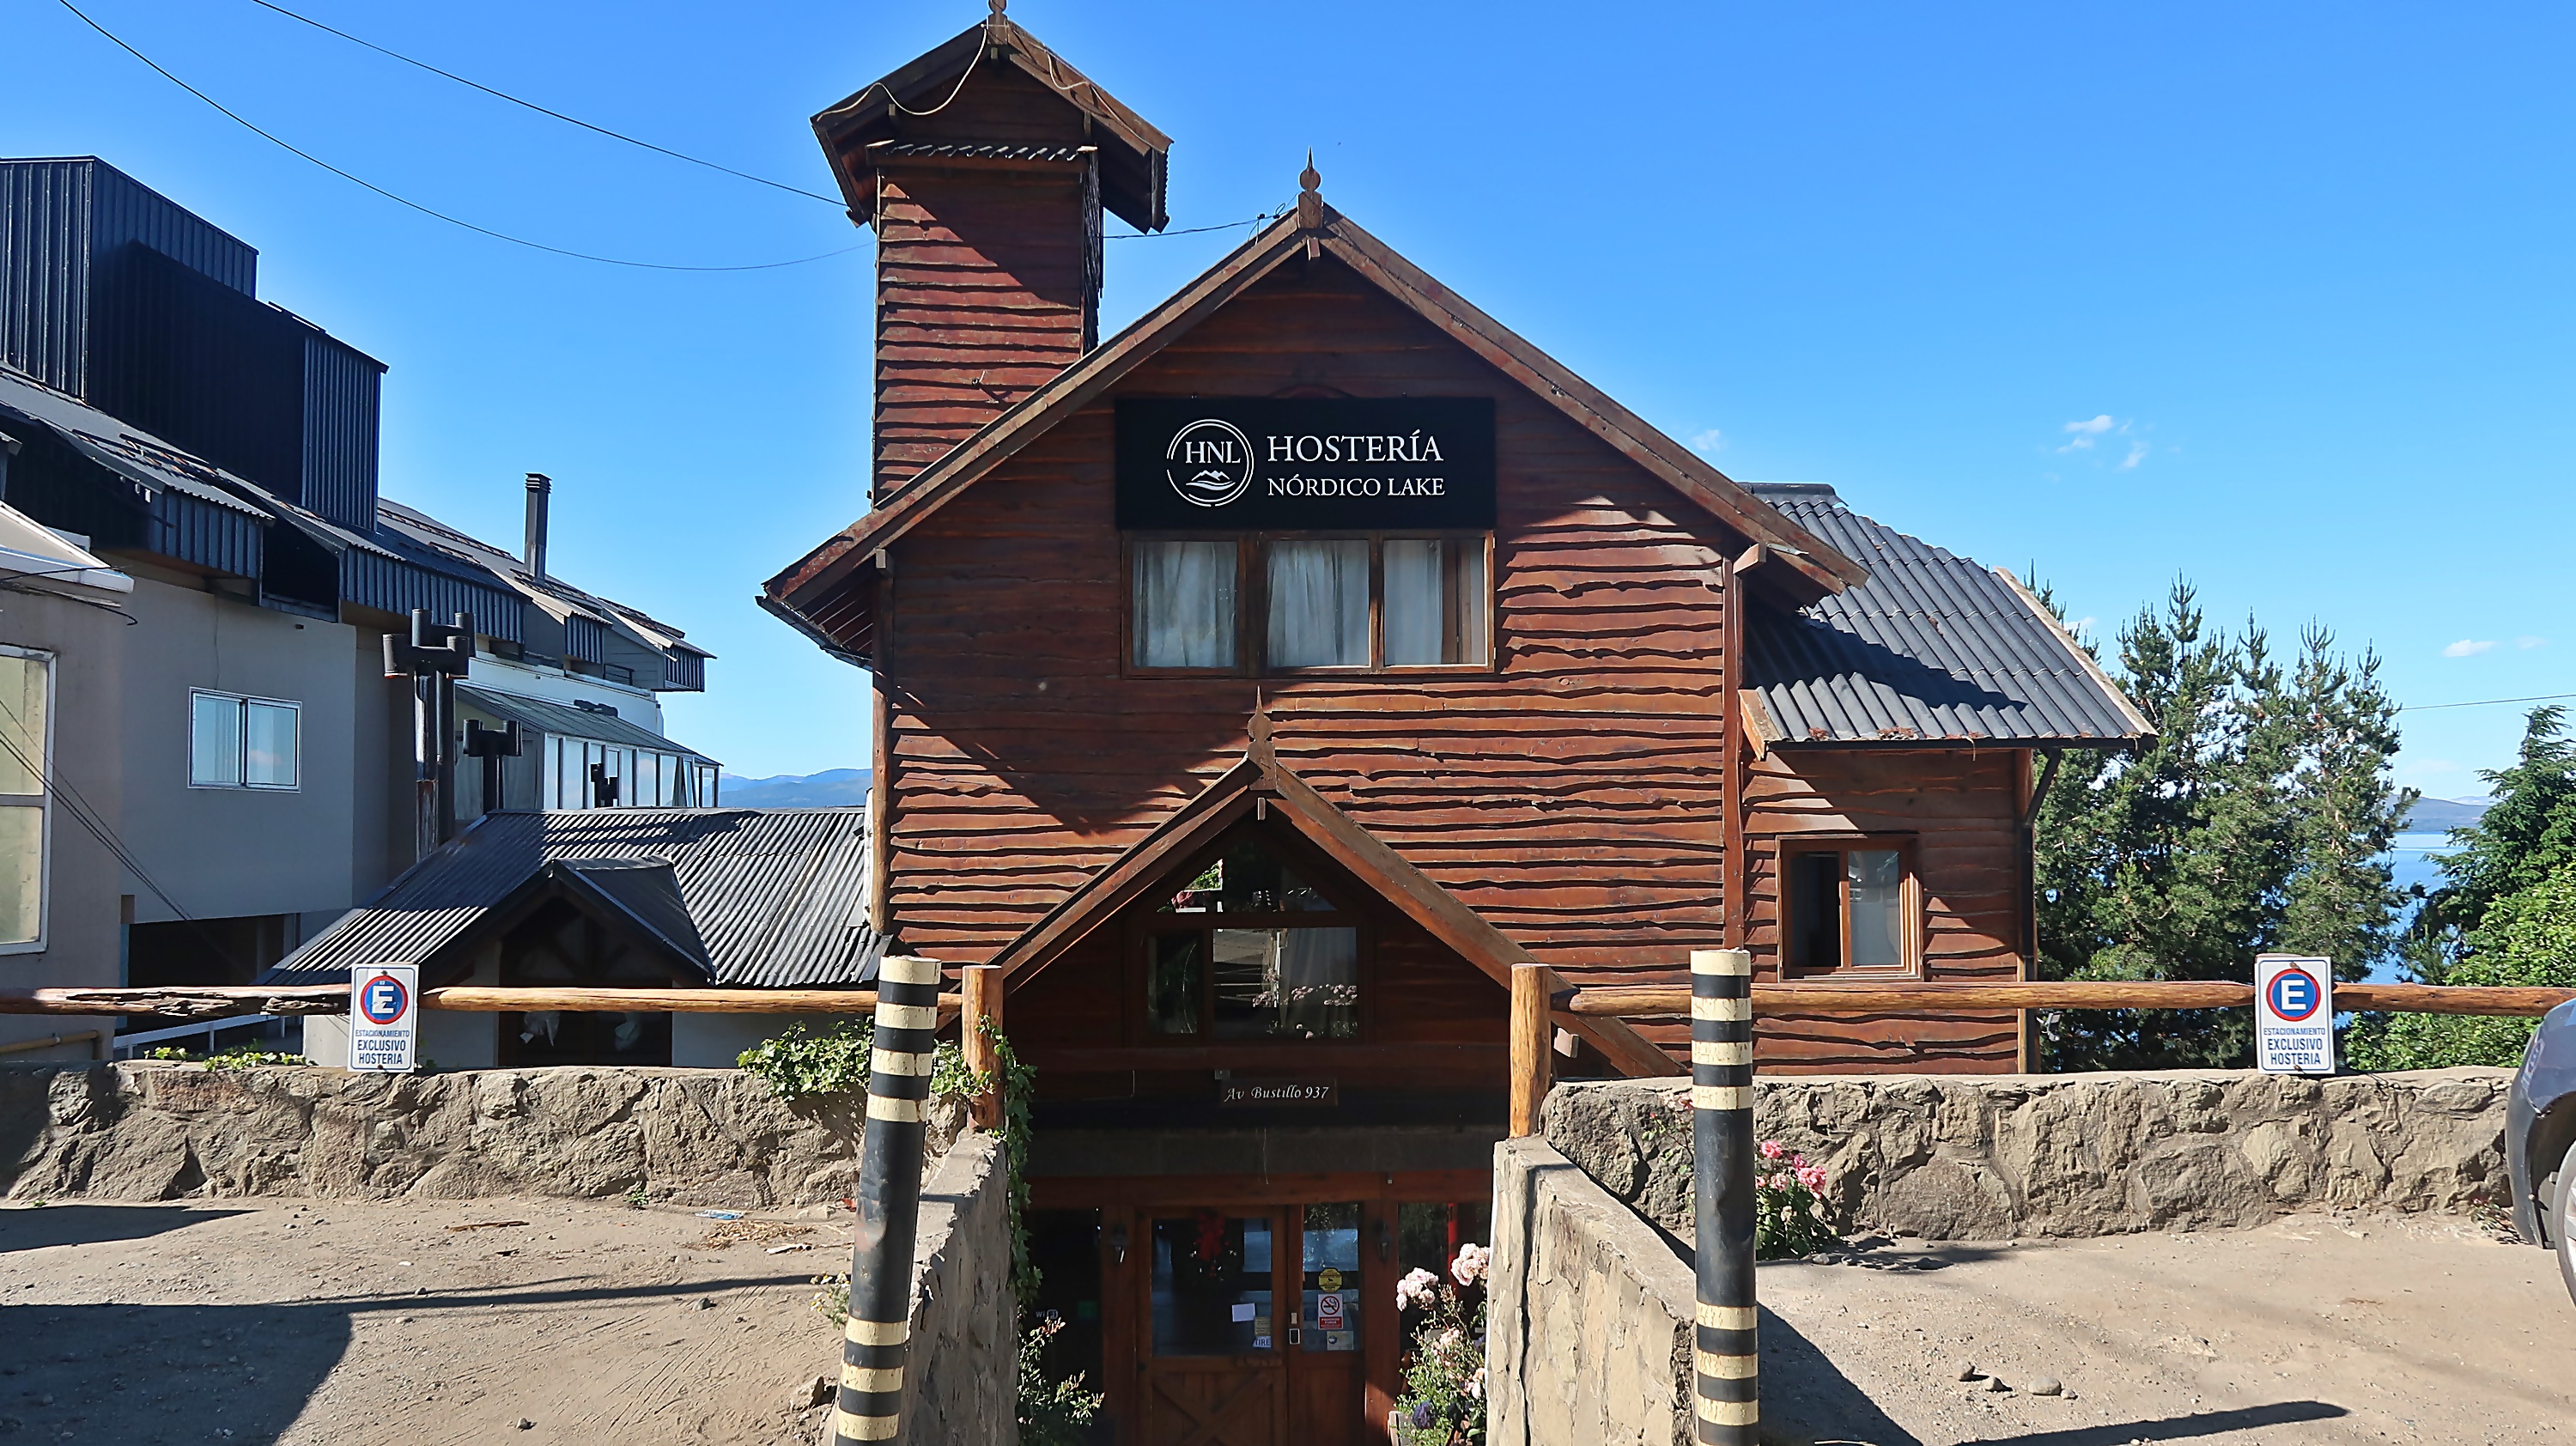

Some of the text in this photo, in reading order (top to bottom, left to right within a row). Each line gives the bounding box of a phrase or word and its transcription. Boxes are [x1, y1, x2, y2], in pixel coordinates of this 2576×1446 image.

[1185, 440, 1241, 464] HNL
[1267, 428, 1444, 463] HOSTERÍA
[1267, 473, 1445, 496] NÓRDICO LAKE
[372, 985, 394, 1014] E
[2281, 979, 2306, 1010] E
[2263, 1027, 2325, 1036] ESTACIONAMIENTO
[357, 1039, 406, 1051] EXCLUSIVO
[2267, 1038, 2323, 1050] EXCLUSIVO
[359, 1053, 403, 1064] HOSTERIA
[2270, 1052, 2322, 1065] HOSTERIA
[1224, 1084, 1329, 1102] Av Bustillo 937
